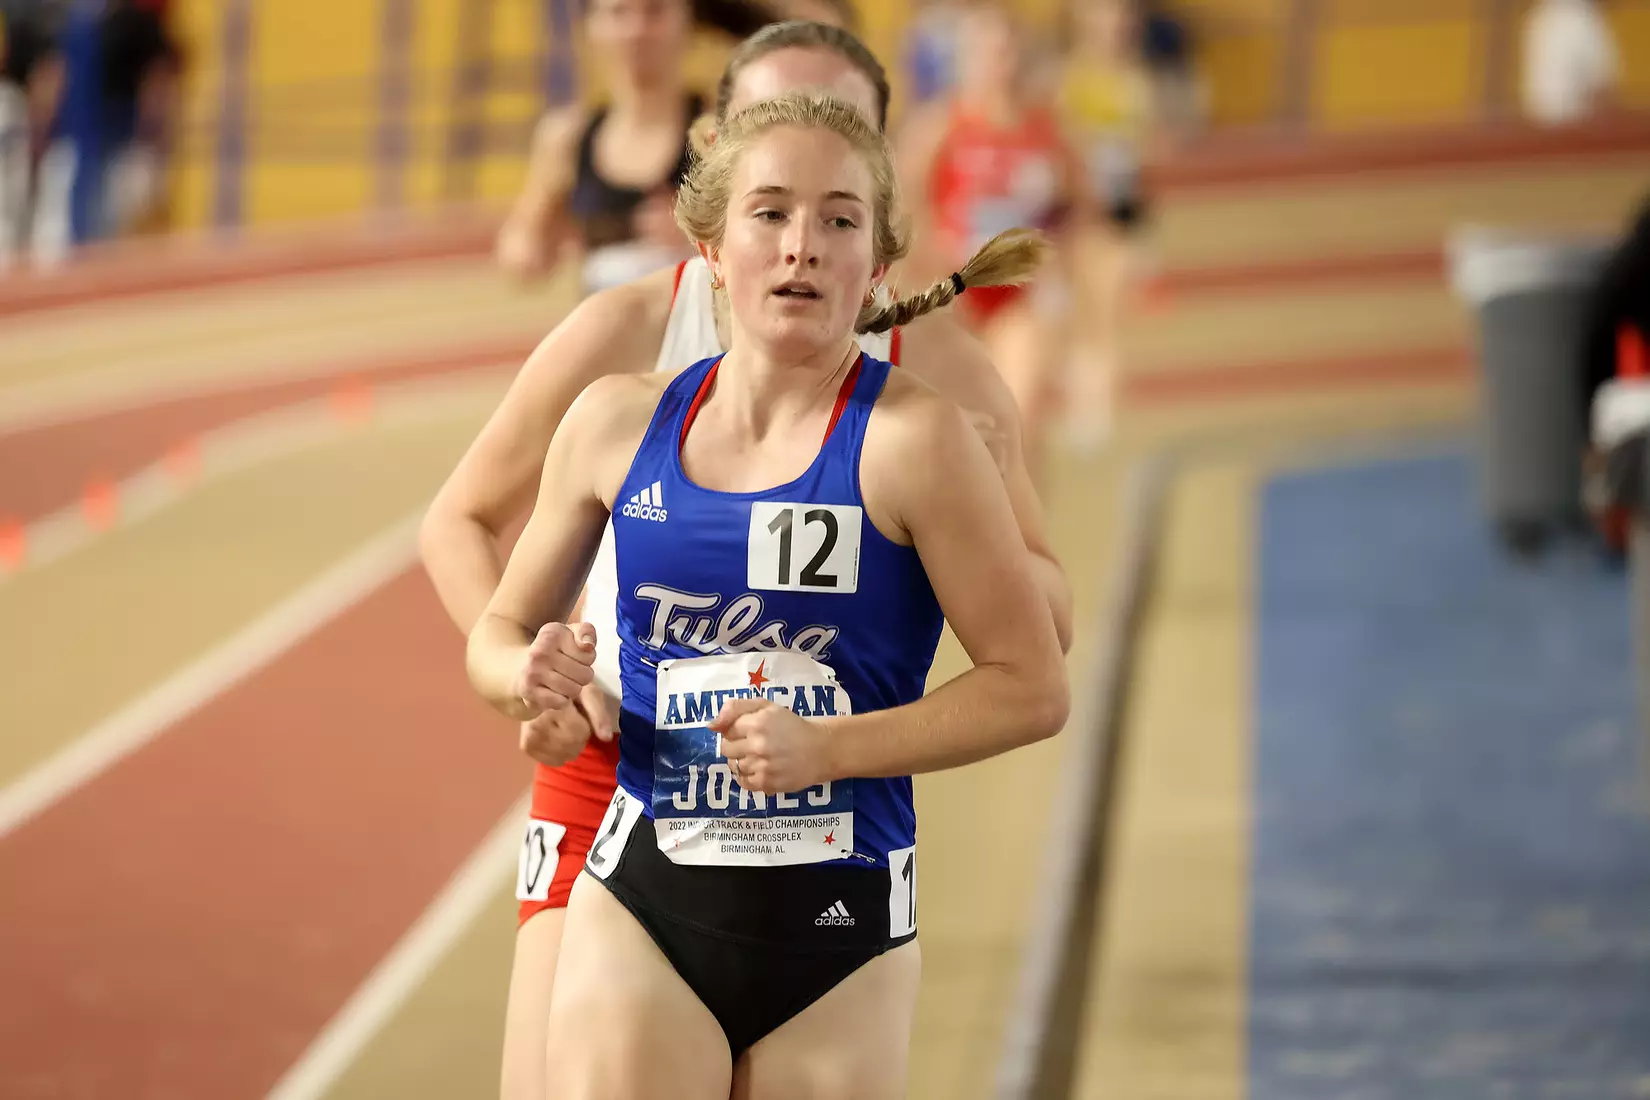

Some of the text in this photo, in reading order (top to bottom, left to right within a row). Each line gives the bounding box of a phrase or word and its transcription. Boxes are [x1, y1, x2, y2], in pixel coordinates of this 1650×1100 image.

[623, 502, 668, 523] adidas
[767, 508, 839, 588] 12
[634, 582, 840, 661] Tulsa
[669, 821, 686, 831] 2022
[717, 819, 744, 830] TRACK
[745, 820, 752, 830] &
[753, 819, 774, 830] FIELD
[775, 816, 840, 829] CHAMPIONSHIPS
[704, 832, 802, 842] BIRMINGHAM CROSSPLEX
[775, 845, 785, 854] AL
[814, 916, 856, 927] adidas
